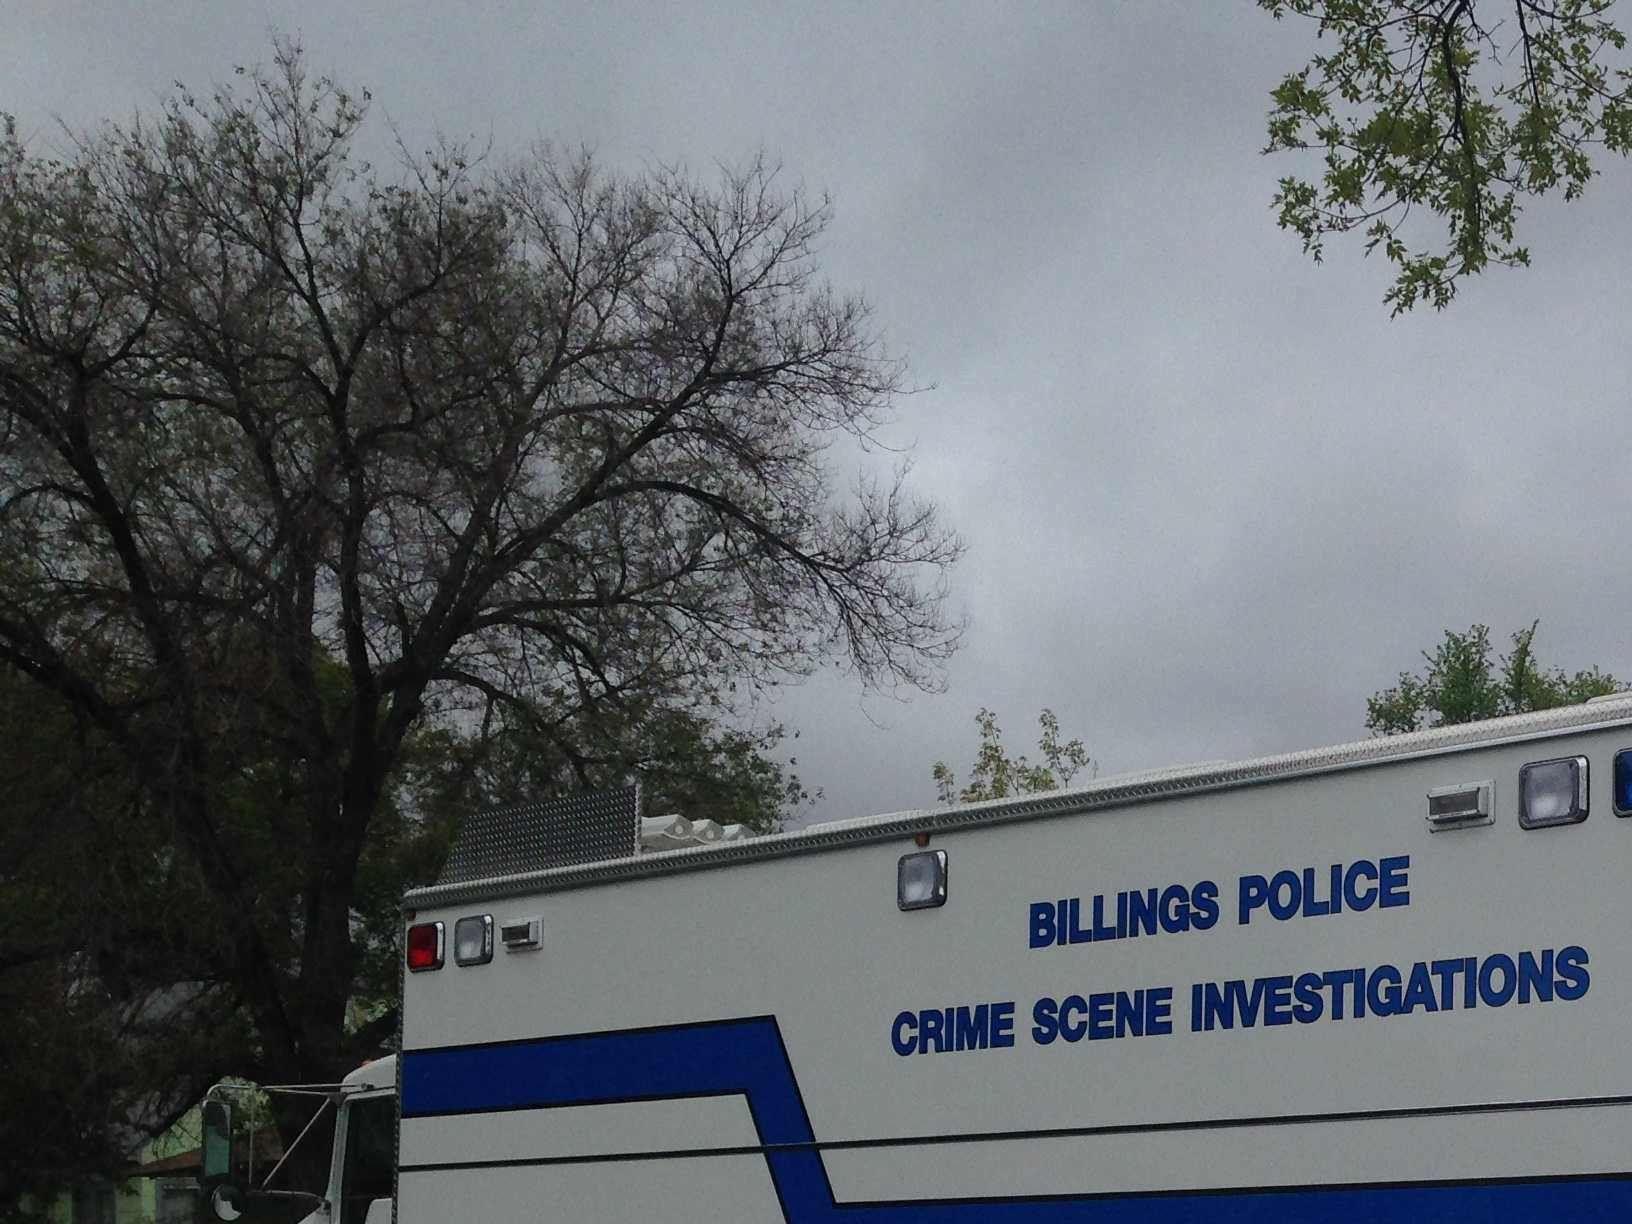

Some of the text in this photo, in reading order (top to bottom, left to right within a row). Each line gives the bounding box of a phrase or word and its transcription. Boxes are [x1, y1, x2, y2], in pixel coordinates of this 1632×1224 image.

[1029, 856, 1410, 948] BILLINGS POLICE
[891, 945, 1590, 1056] CRIME SCENE INVESTIGATIONS
